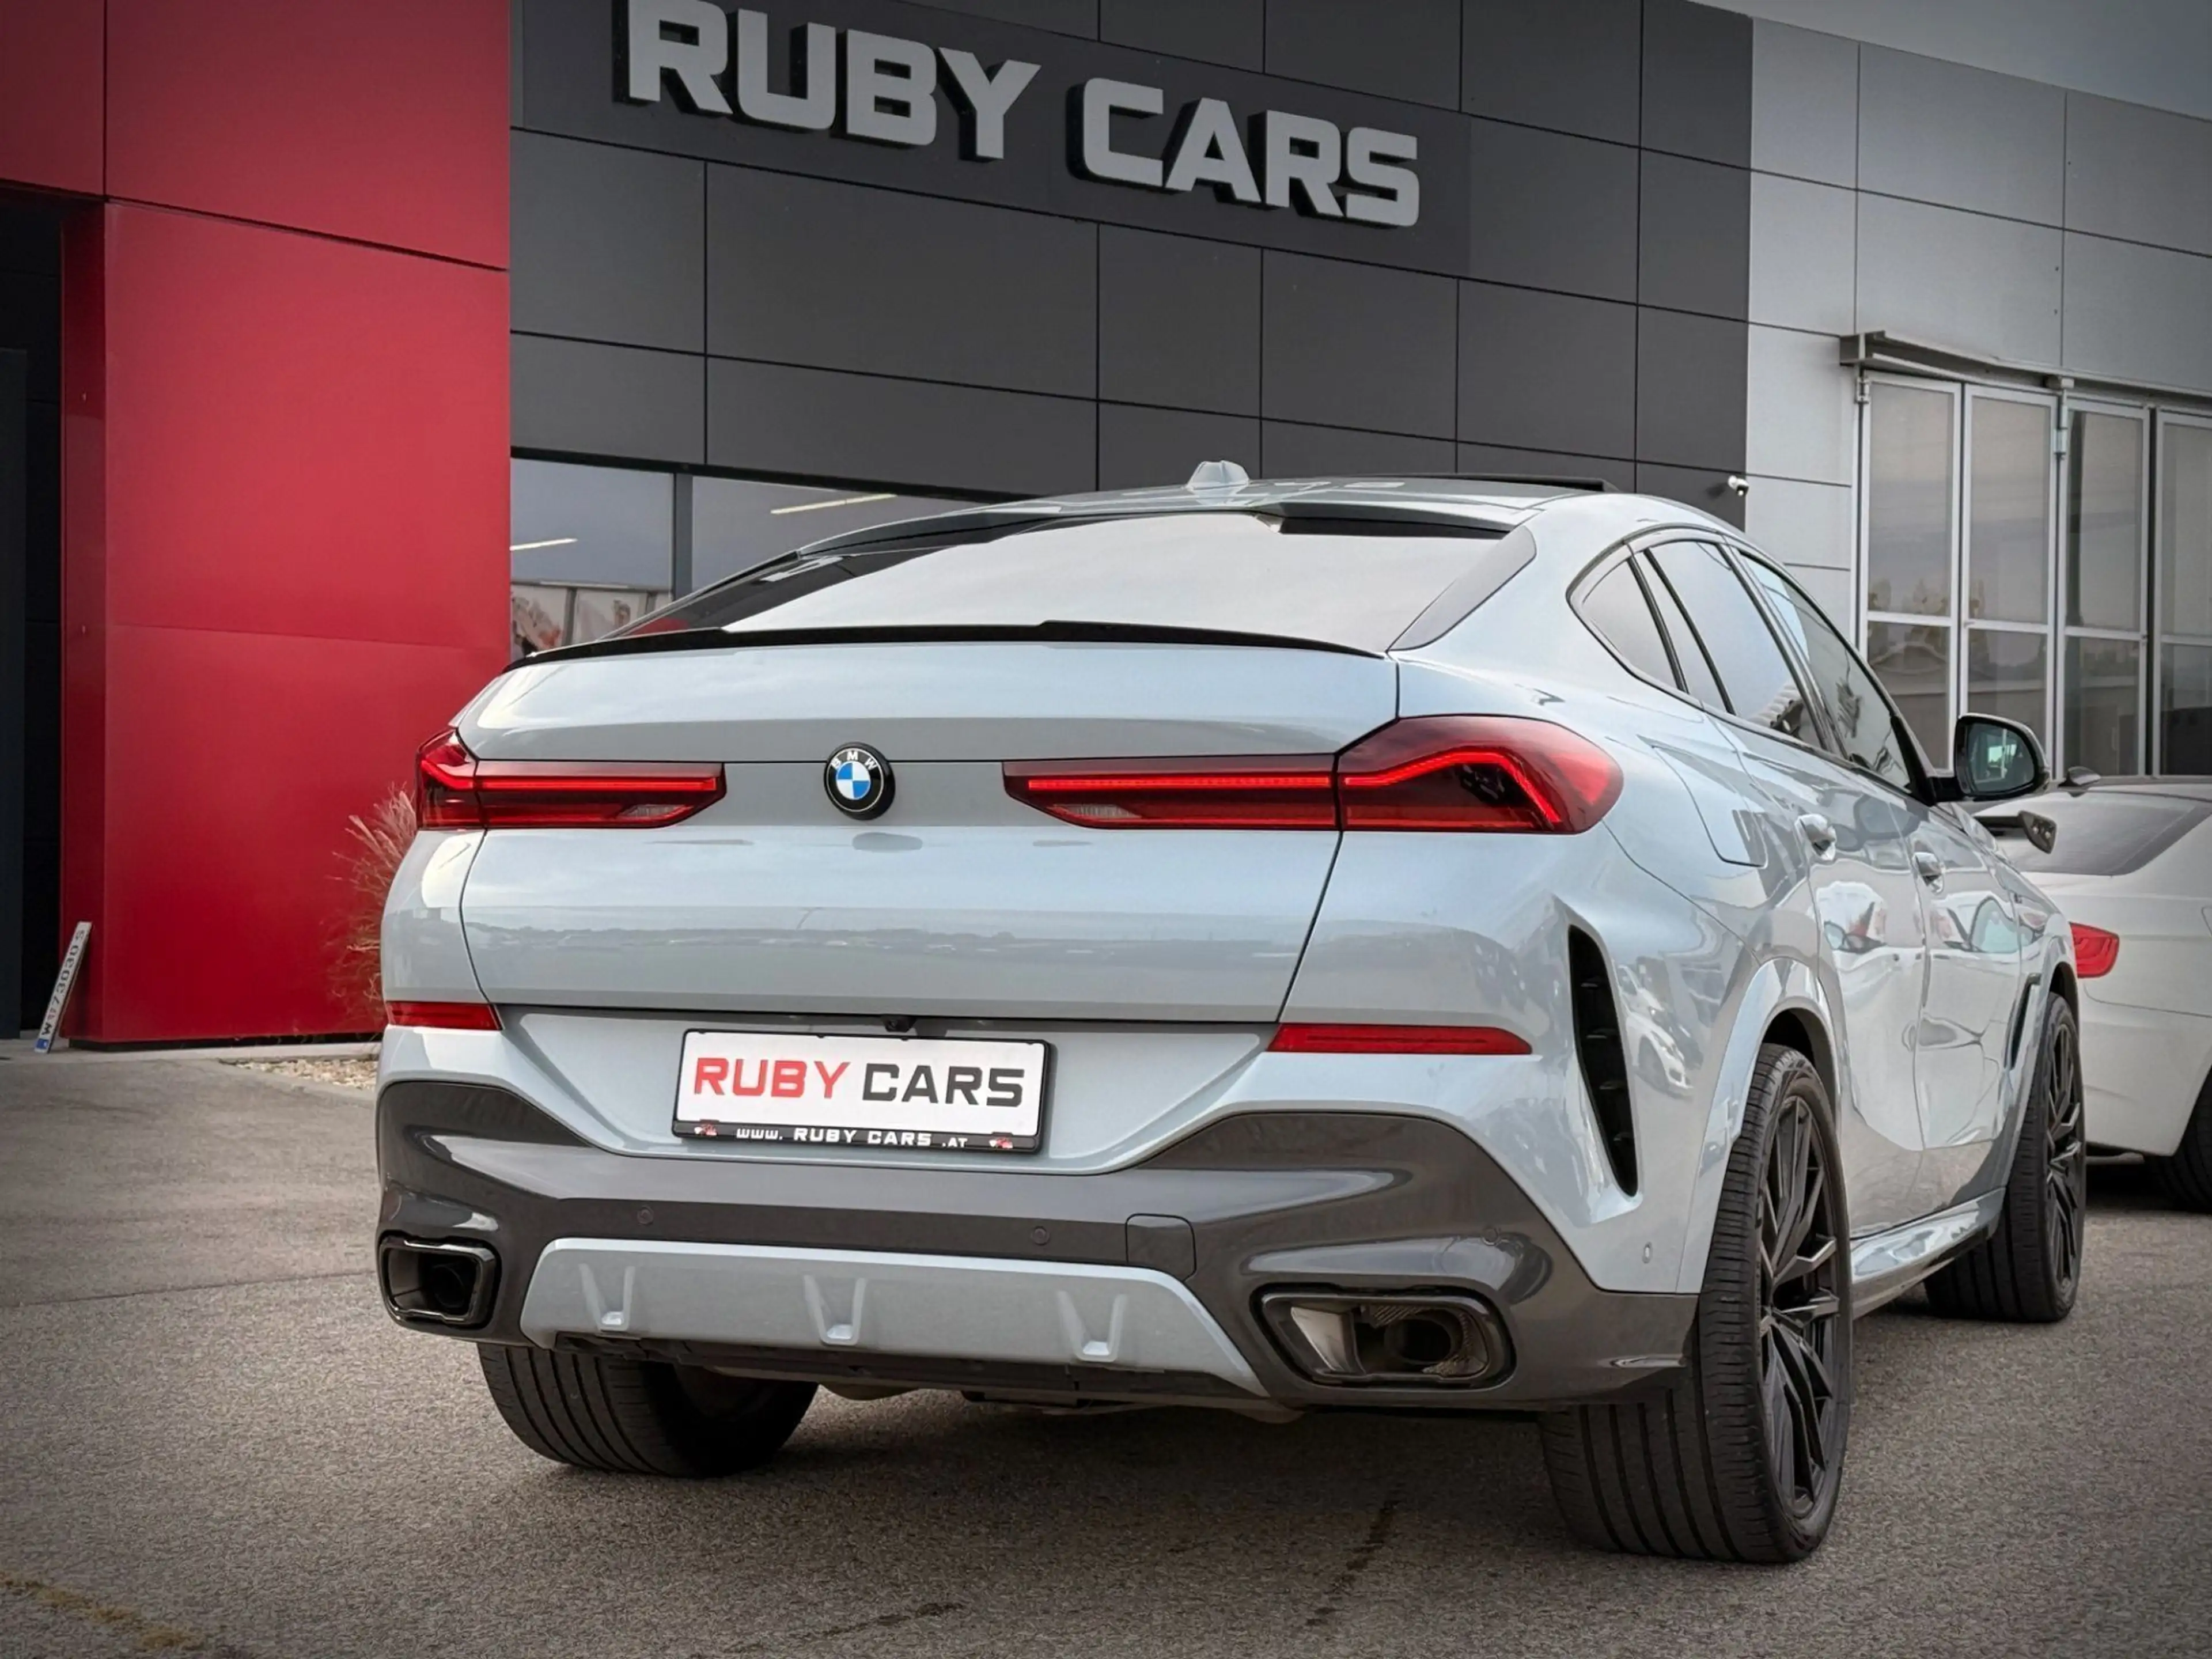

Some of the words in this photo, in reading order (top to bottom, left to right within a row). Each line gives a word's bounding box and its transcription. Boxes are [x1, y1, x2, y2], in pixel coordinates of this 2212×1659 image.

[628, 0, 1041, 159] RUBY
[1082, 77, 1420, 227] CARS
[830, 751, 877, 770] BMW
[41, 1022, 52, 1036] W
[694, 1057, 851, 1099] RUBY
[862, 1063, 1025, 1108] CARS
[794, 1127, 857, 1144] RUBY
[867, 1130, 932, 1147] CARS
[941, 1137, 968, 1148] .AT
